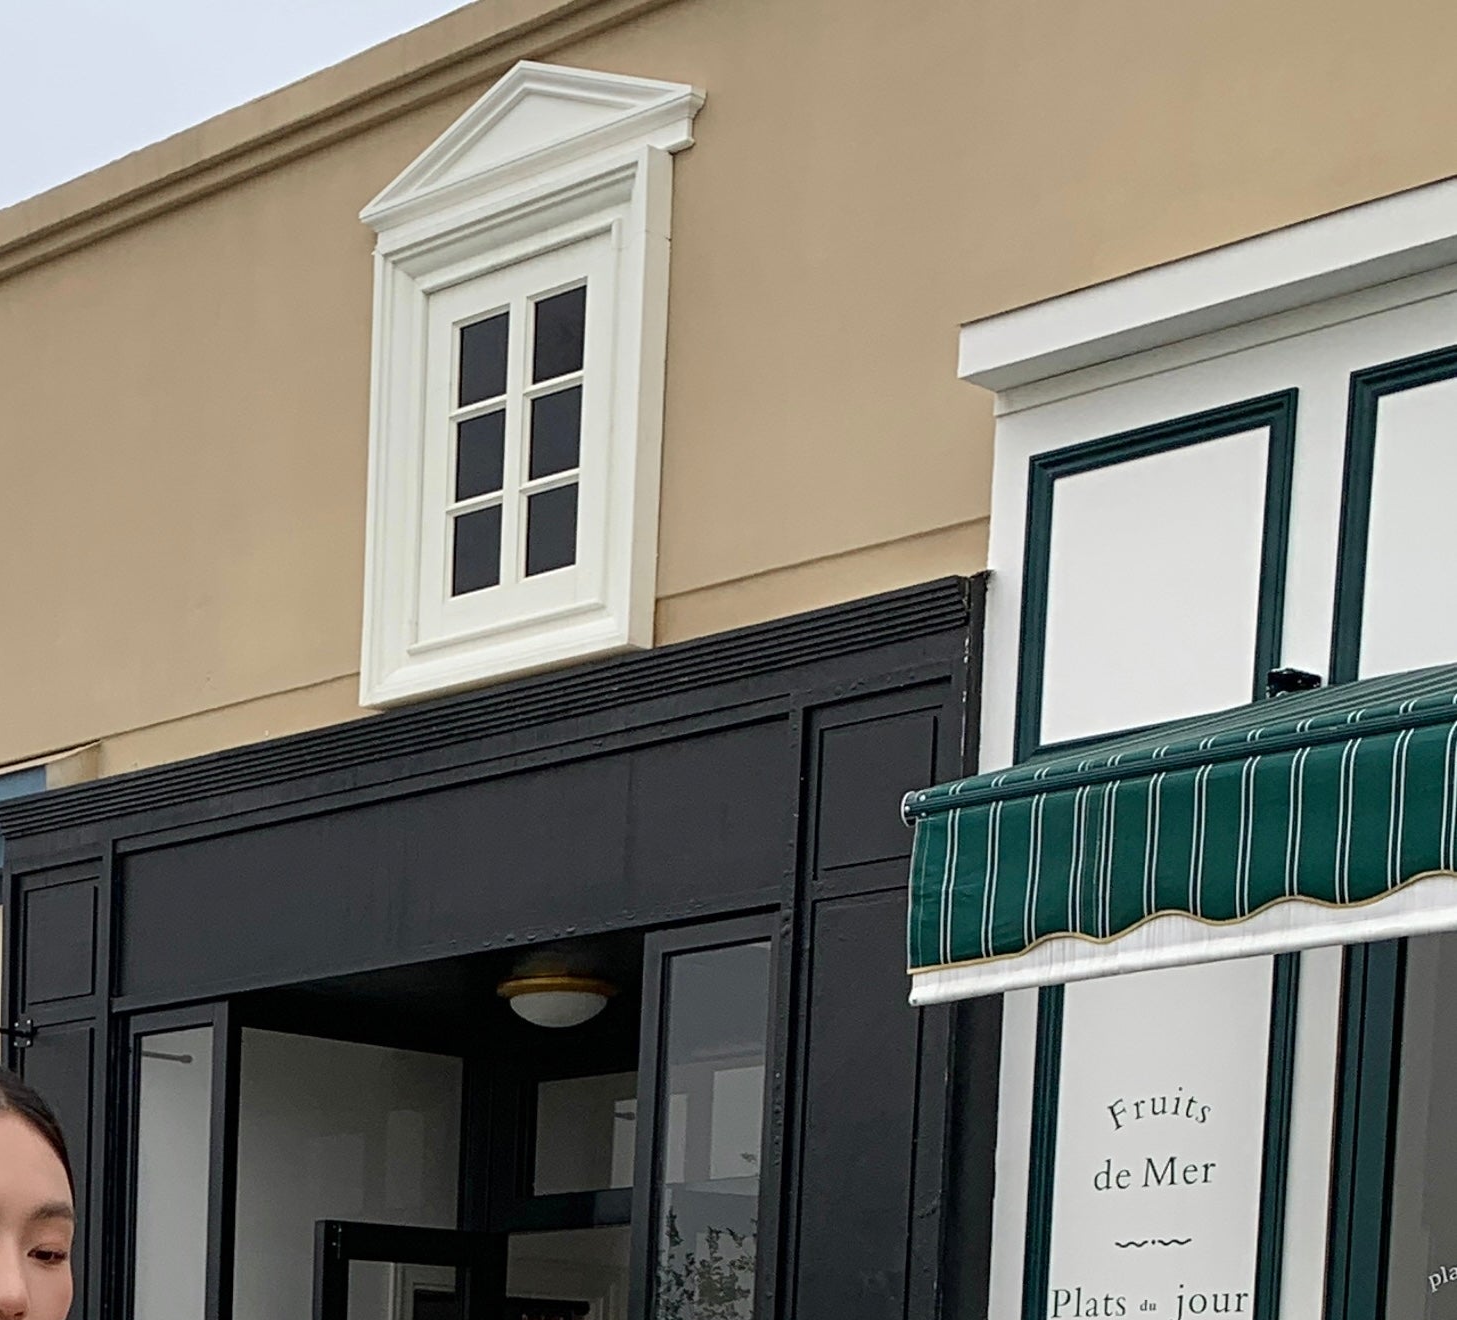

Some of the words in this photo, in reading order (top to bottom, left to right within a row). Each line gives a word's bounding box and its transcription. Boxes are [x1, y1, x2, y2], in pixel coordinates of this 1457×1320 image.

[1107, 1087, 1212, 1130] Fruits
[1093, 1159, 1131, 1190] de
[1142, 1157, 1216, 1188] Mer
[1051, 1287, 1127, 1319] Plats
[1139, 1299, 1157, 1312] du
